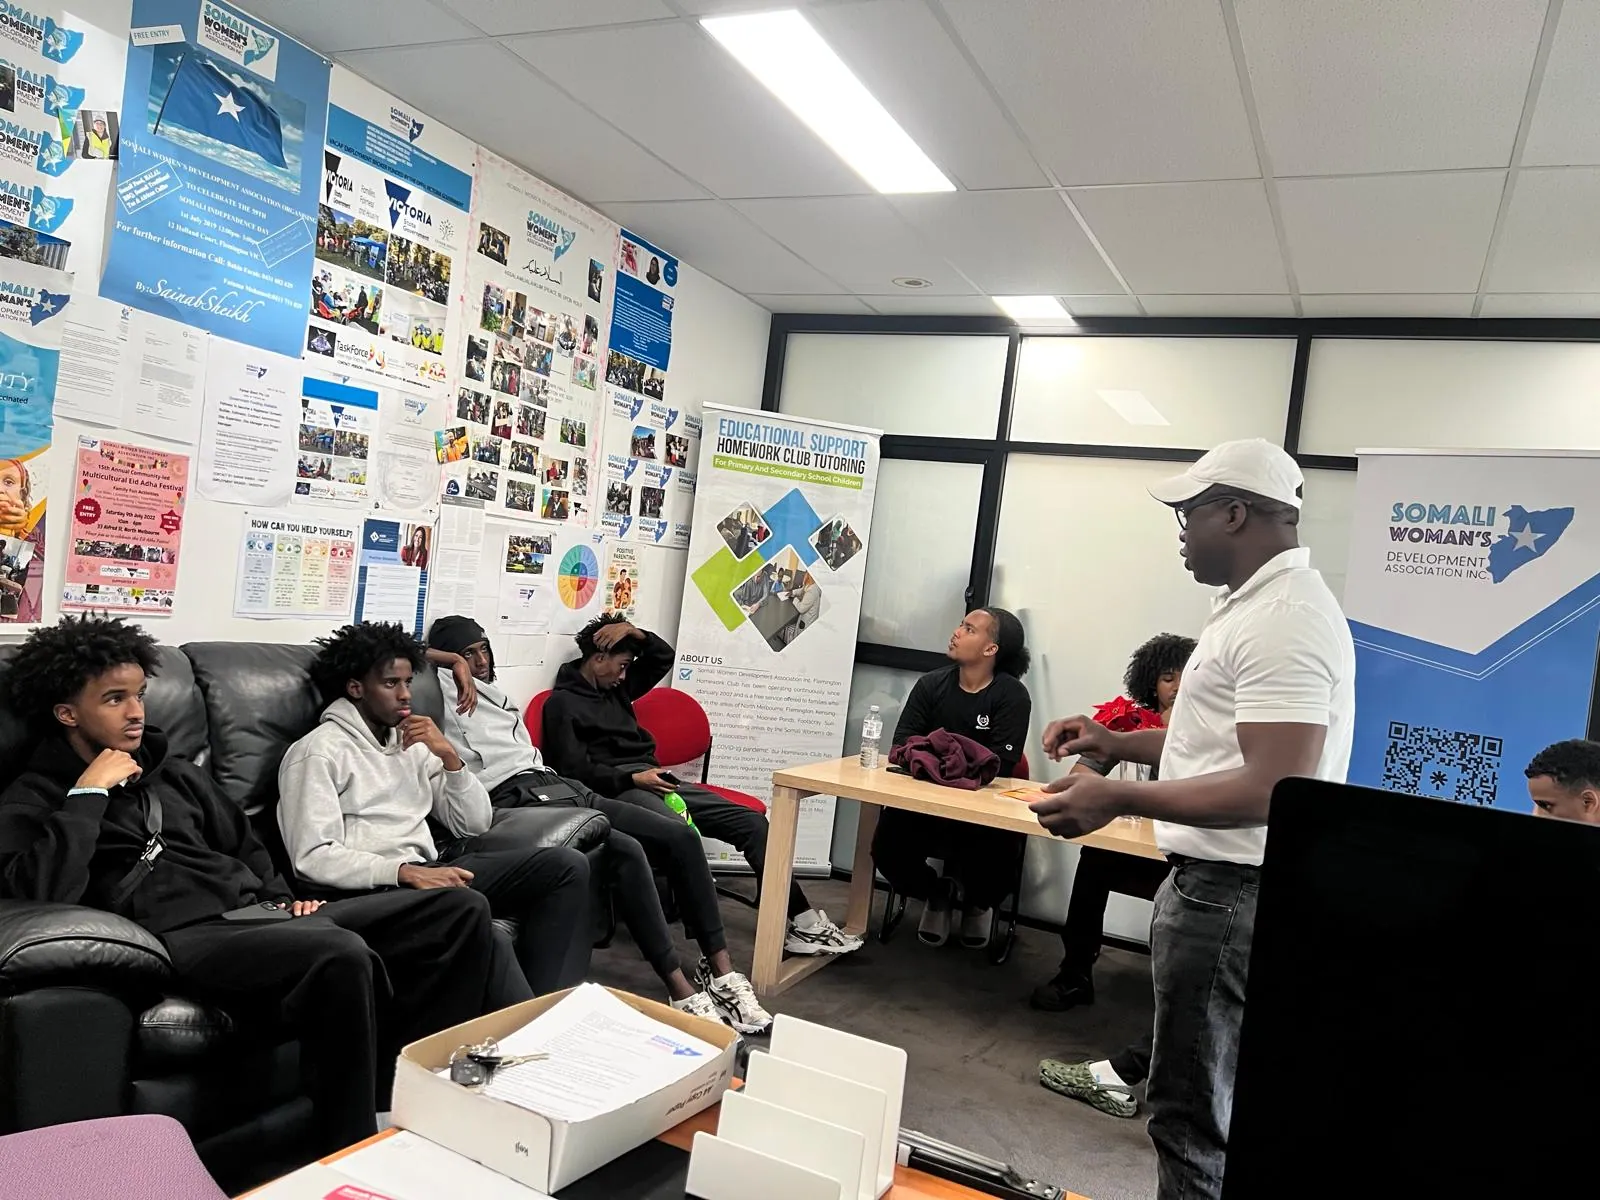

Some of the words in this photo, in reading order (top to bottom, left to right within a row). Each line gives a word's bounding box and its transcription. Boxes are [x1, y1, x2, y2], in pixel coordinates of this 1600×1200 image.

[204, 3, 249, 37] SOMALI
[150, 29, 170, 38] ENTRY
[203, 15, 248, 46] WOMEN'S
[204, 26, 245, 49] DEVELOPMENT
[188, 166, 240, 191] DEVELOPMENT
[241, 186, 282, 209] ASSOCIATION
[178, 194, 207, 211] SOMALI
[387, 195, 433, 227] VICTORIA
[526, 220, 558, 244] WOMEN'S
[527, 210, 560, 235] SOMALI
[117, 220, 131, 234] For
[132, 227, 161, 244] further
[161, 236, 207, 260] information
[207, 252, 226, 267] Call:
[336, 340, 369, 358] TaskForce
[719, 418, 806, 449] EDUCATIONAL
[809, 433, 868, 459] SUPPORT
[716, 437, 785, 462] HOMEWORK
[783, 448, 811, 466] CLUB
[813, 453, 865, 475] TUTORING
[110, 465, 130, 474] Annual
[715, 458, 728, 467] For
[727, 460, 755, 473] Primary
[754, 464, 769, 473] And
[770, 466, 808, 480] Secondary
[807, 472, 832, 483] School
[832, 475, 861, 487] Children
[82, 471, 128, 483] Multicultural
[128, 478, 139, 486] Eid
[140, 479, 158, 488] Adha
[158, 482, 184, 492] Festival
[113, 486, 129, 494] Family
[105, 509, 126, 518] Saturday
[134, 512, 144, 520] July
[143, 513, 156, 521] 2022
[1391, 503, 1496, 527] SOMALI
[251, 520, 269, 529] HOW
[270, 521, 285, 531] CAN
[286, 523, 300, 533] YOU
[301, 525, 318, 534] HELP
[319, 527, 353, 539] YOURSELF?
[1389, 526, 1492, 547] WOMAN'S
[616, 547, 634, 555] POSITIVE
[1386, 551, 1486, 568] DEVELOPMENT
[1384, 564, 1463, 578] ASSOCIATION
[1466, 569, 1490, 580] INC.
[680, 654, 710, 664] ABOUT
[710, 657, 723, 665] US
[696, 678, 725, 686] Homework
[717, 669, 738, 677] Women
[738, 671, 773, 681] Development
[774, 674, 802, 683] Association
[813, 678, 842, 687] Flemington
[740, 702, 757, 710] North
